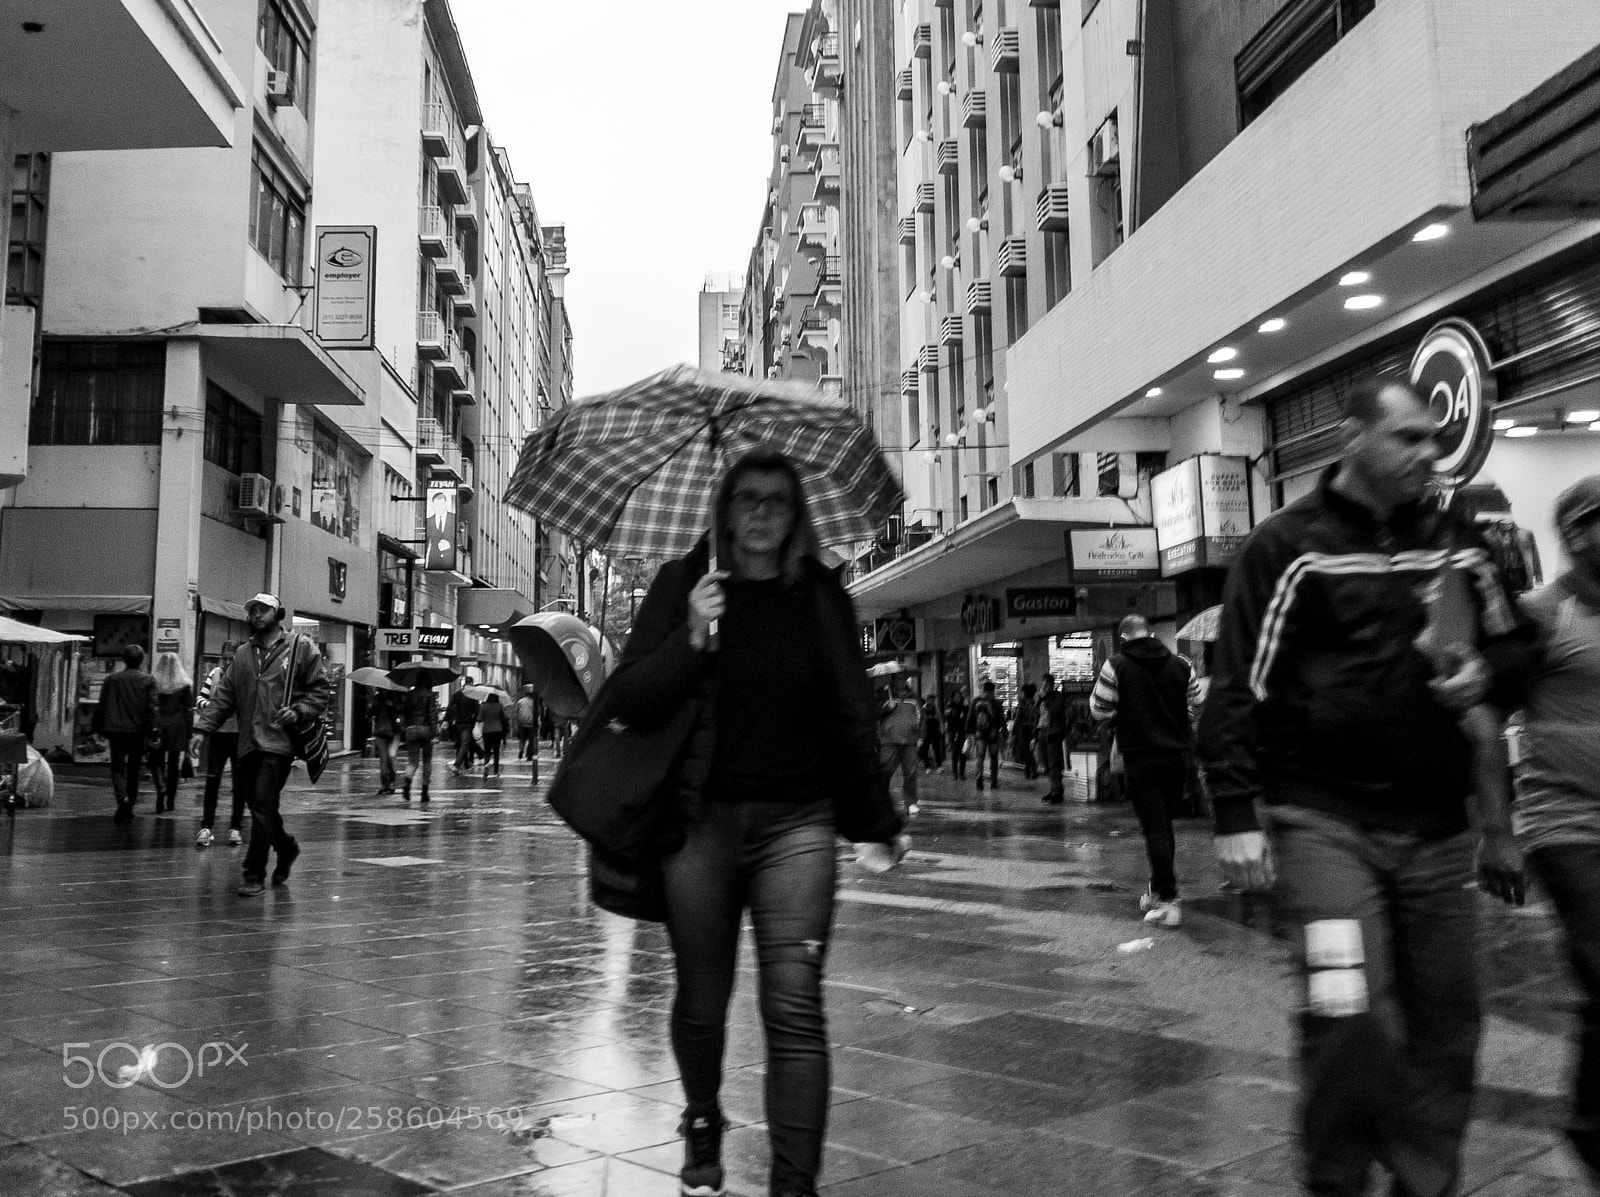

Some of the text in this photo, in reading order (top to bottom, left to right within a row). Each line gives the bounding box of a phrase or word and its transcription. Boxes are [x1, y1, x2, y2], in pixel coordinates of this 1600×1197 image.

[324, 272, 361, 280] employer
[1013, 595, 1070, 611] Gaston
[418, 634, 449, 645] TEVAH
